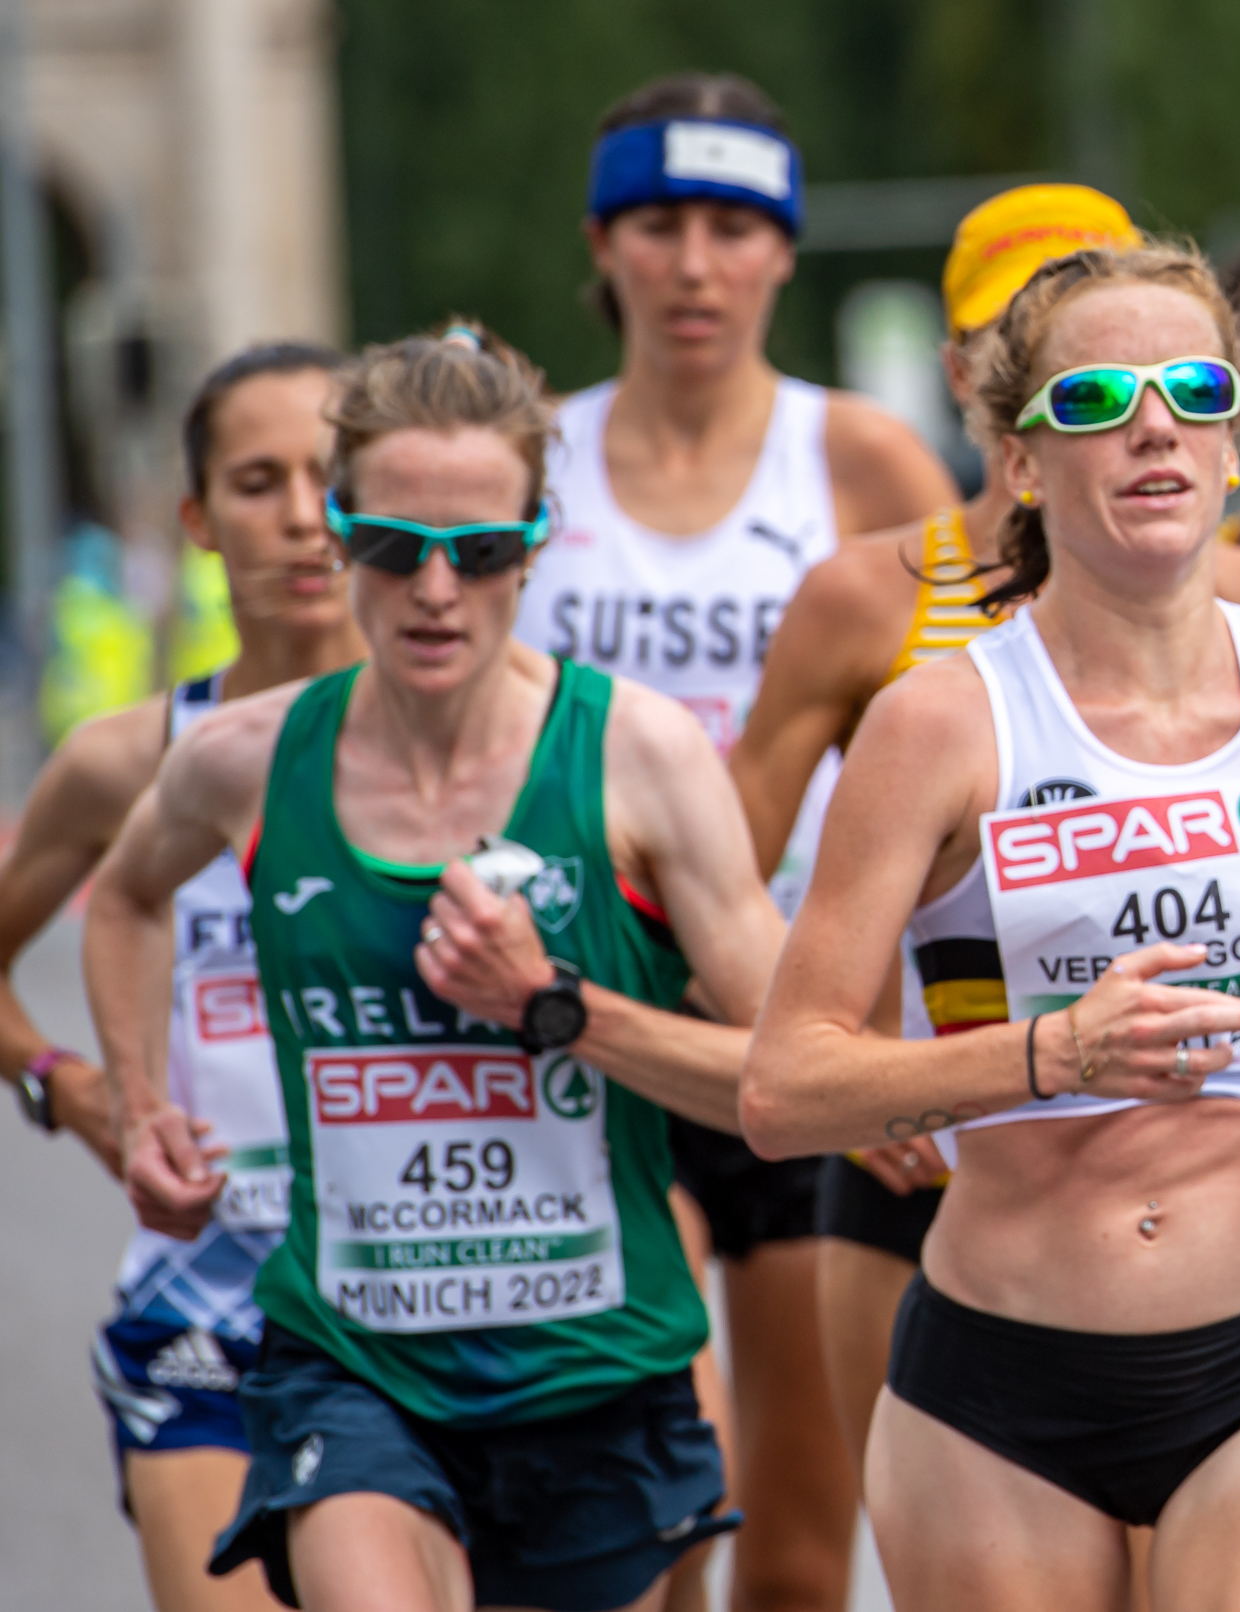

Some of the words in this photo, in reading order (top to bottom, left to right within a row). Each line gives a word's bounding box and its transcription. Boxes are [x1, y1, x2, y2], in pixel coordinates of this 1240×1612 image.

[998, 798, 1232, 881] SPAR
[1112, 879, 1230, 944] 404
[318, 1061, 530, 1117] SPAR
[401, 1140, 515, 1195] 459
[349, 1193, 586, 1232] MCCORMACK
[388, 1243, 451, 1268] RUN
[337, 1277, 492, 1318] MUNICH
[509, 1264, 602, 1310] 2022
